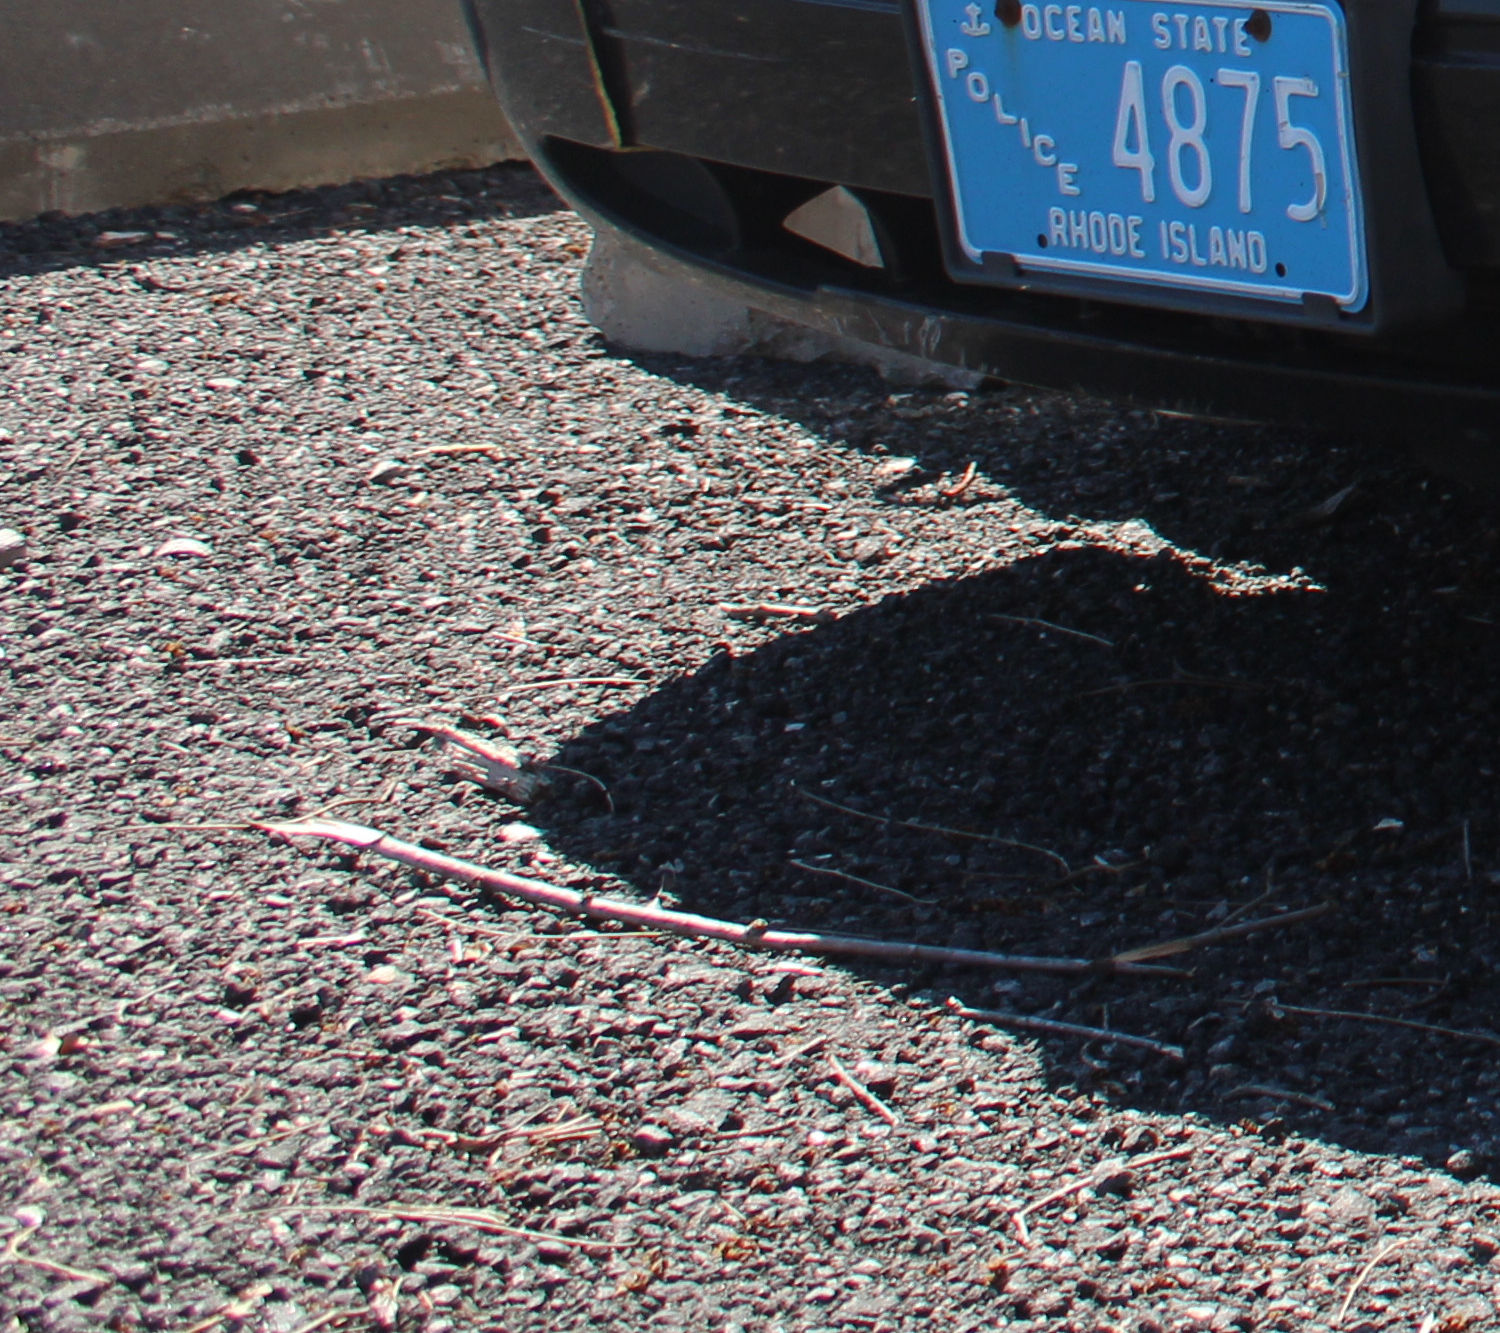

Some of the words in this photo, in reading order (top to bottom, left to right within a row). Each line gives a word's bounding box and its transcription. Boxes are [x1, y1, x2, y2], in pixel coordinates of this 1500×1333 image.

[1020, 2, 1127, 46] OCEAN
[1150, 12, 1254, 58] STATE
[945, 47, 1082, 197] POLICE
[1112, 59, 1327, 222] 4875
[1047, 206, 1146, 260] RHODE
[1160, 218, 1268, 275] ISLAND
